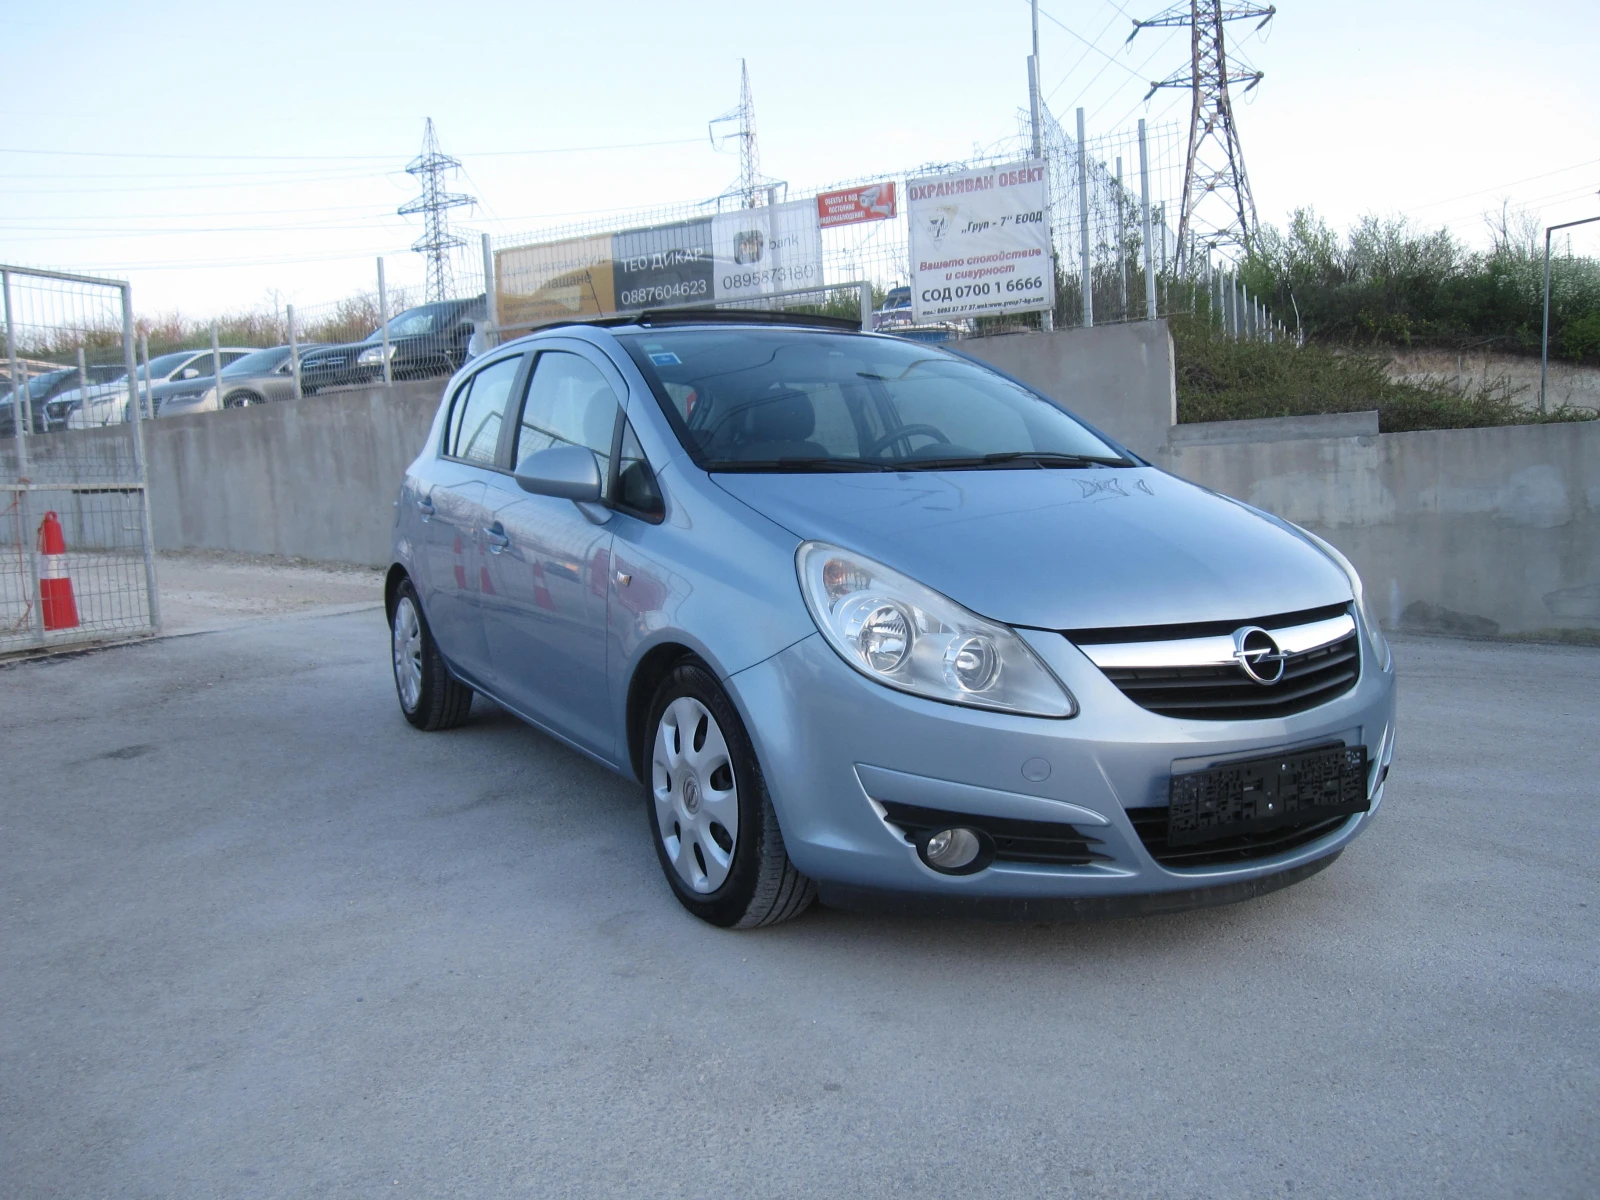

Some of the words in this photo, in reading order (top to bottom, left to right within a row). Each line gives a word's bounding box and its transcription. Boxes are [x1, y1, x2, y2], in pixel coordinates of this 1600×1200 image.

[909, 175, 994, 201] ОХРАНЯВАН
[998, 166, 1045, 188] ОБЕКТ
[1015, 211, 1043, 225] ЕООД
[769, 233, 799, 250] bank
[621, 256, 648, 273] ТЕО
[651, 247, 703, 271] ДИКАР
[920, 257, 965, 272] Вашето
[966, 248, 1042, 266] спокойствие
[945, 272, 953, 281] и
[955, 264, 1015, 281] сигурност
[723, 265, 814, 290] 0895873180
[922, 287, 953, 303] СОД
[955, 282, 990, 299] 0700
[995, 281, 1001, 294] 1
[1006, 276, 1043, 293] 6666
[621, 279, 707, 304] 0887604623
